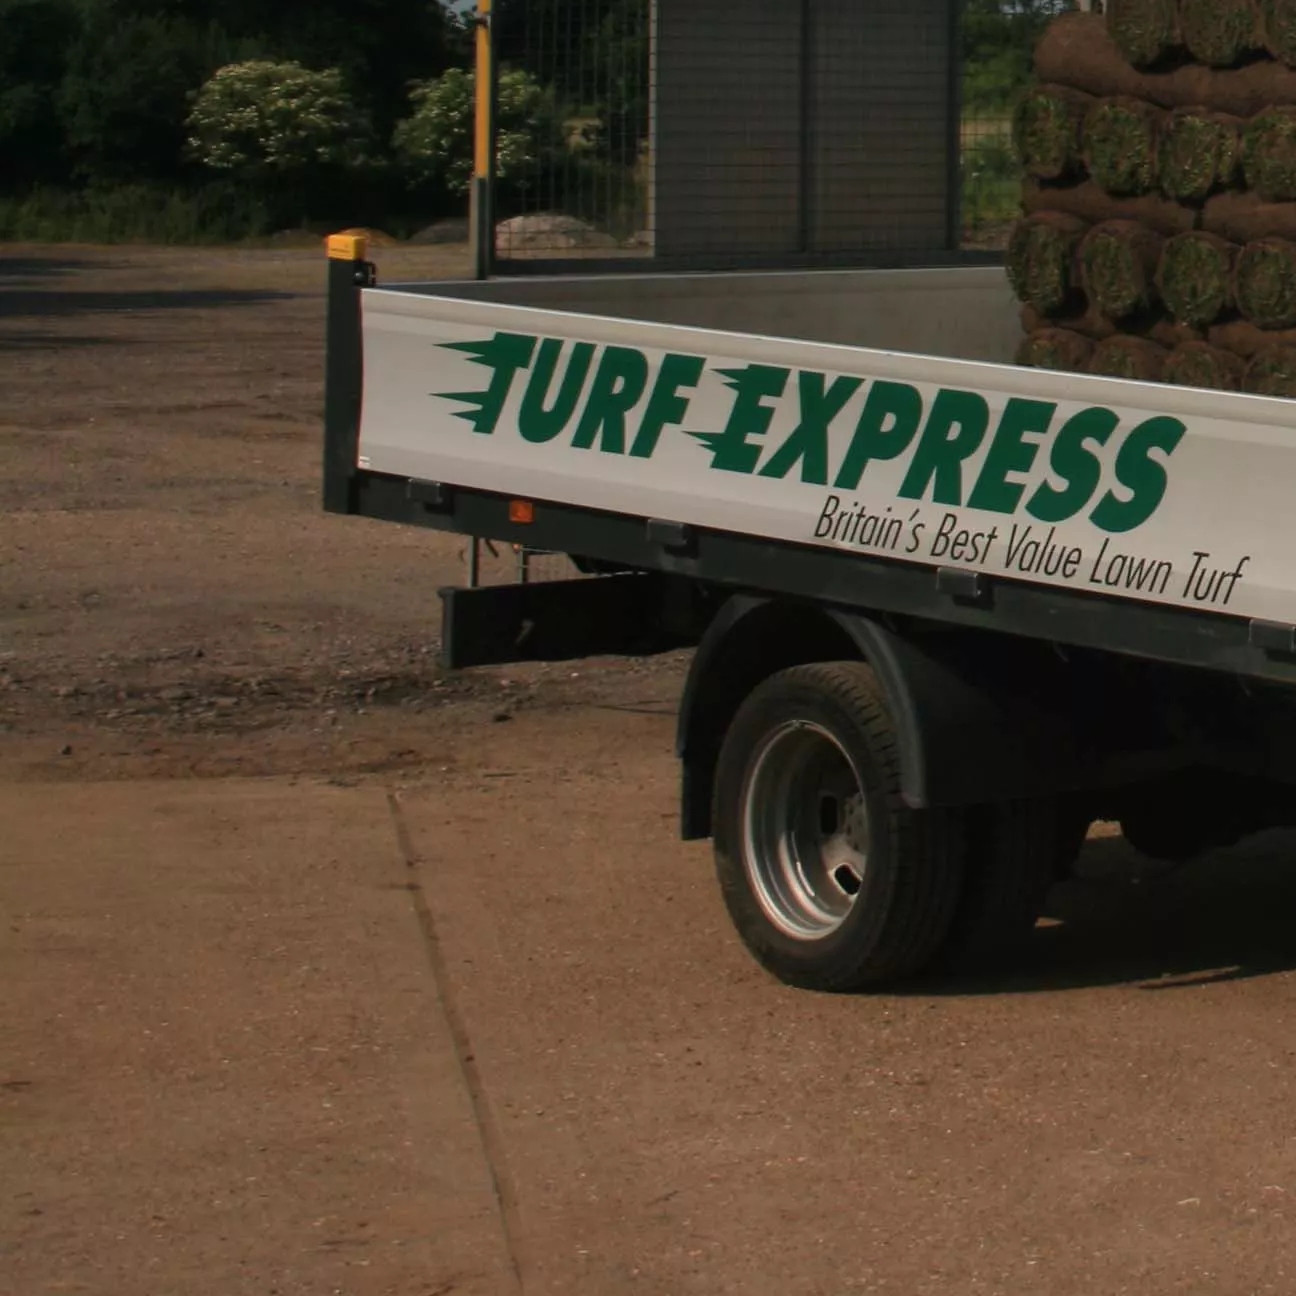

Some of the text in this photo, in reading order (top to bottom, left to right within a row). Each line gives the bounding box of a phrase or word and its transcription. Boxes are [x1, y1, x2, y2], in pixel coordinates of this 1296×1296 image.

[431, 330, 1188, 534] TURF EXPRESS
[814, 494, 1250, 605] Britain's Best Value Lawn Turf
